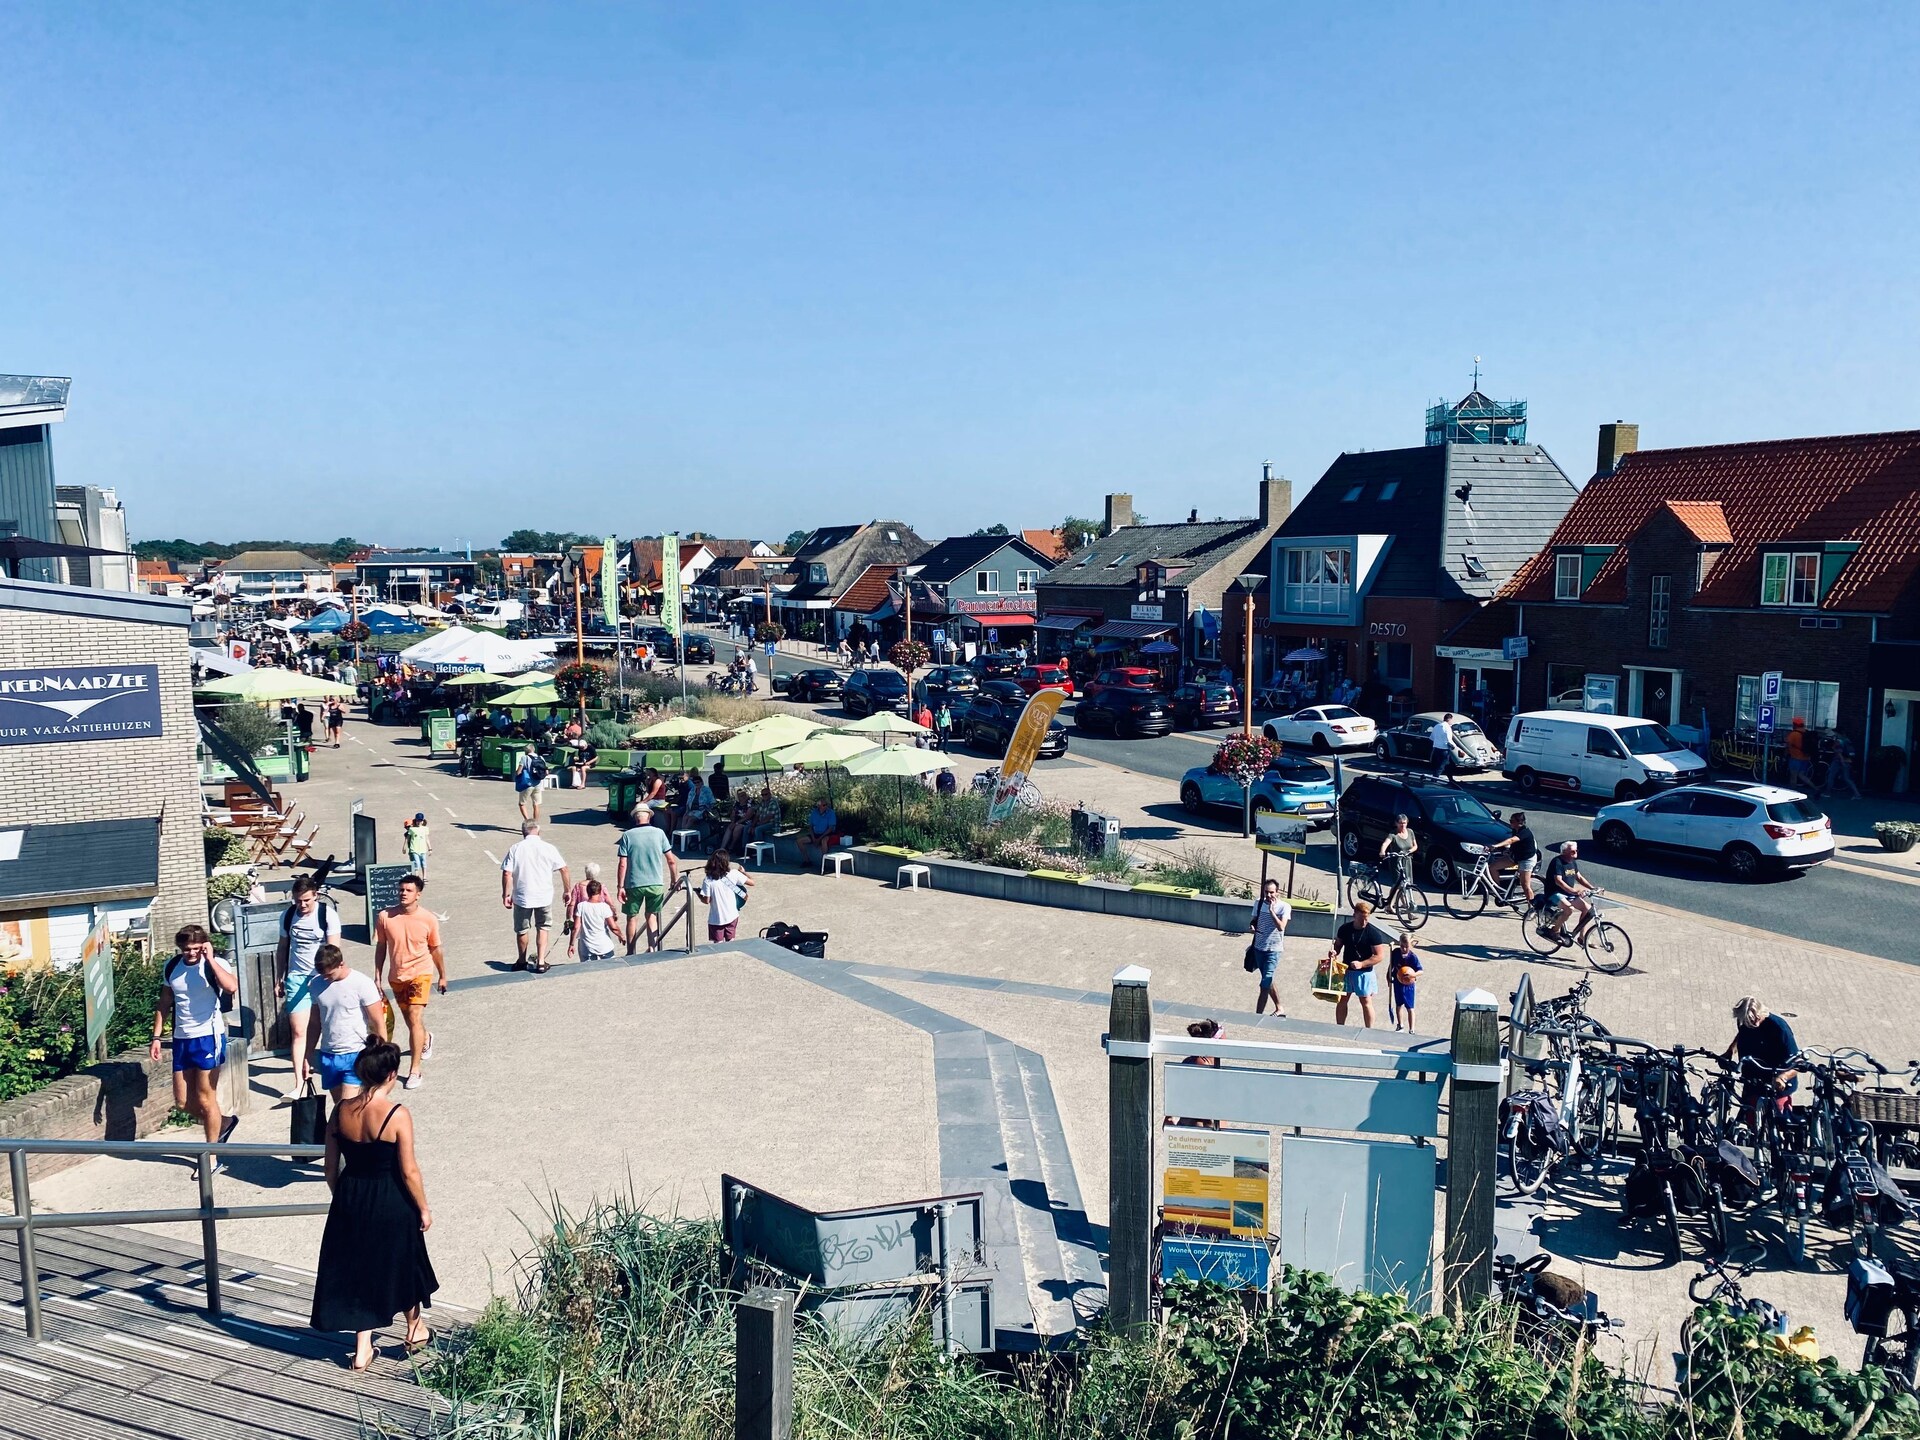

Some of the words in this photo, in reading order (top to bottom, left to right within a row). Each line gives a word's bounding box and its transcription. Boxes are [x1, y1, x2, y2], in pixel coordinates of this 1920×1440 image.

[1241, 616, 1270, 629] DSTO
[1369, 622, 1407, 637] DESTO
[435, 664, 482, 674] Heineken
[1769, 681, 1776, 693] P
[1761, 708, 1770, 721] P
[33, 721, 152, 735] VAKANTIEHUIZEN
[1177, 1136, 1201, 1144] duinen
[1168, 1142, 1207, 1152] Callantsoog
[1168, 1246, 1191, 1254] Wonen
[1193, 1248, 1212, 1256] onder
